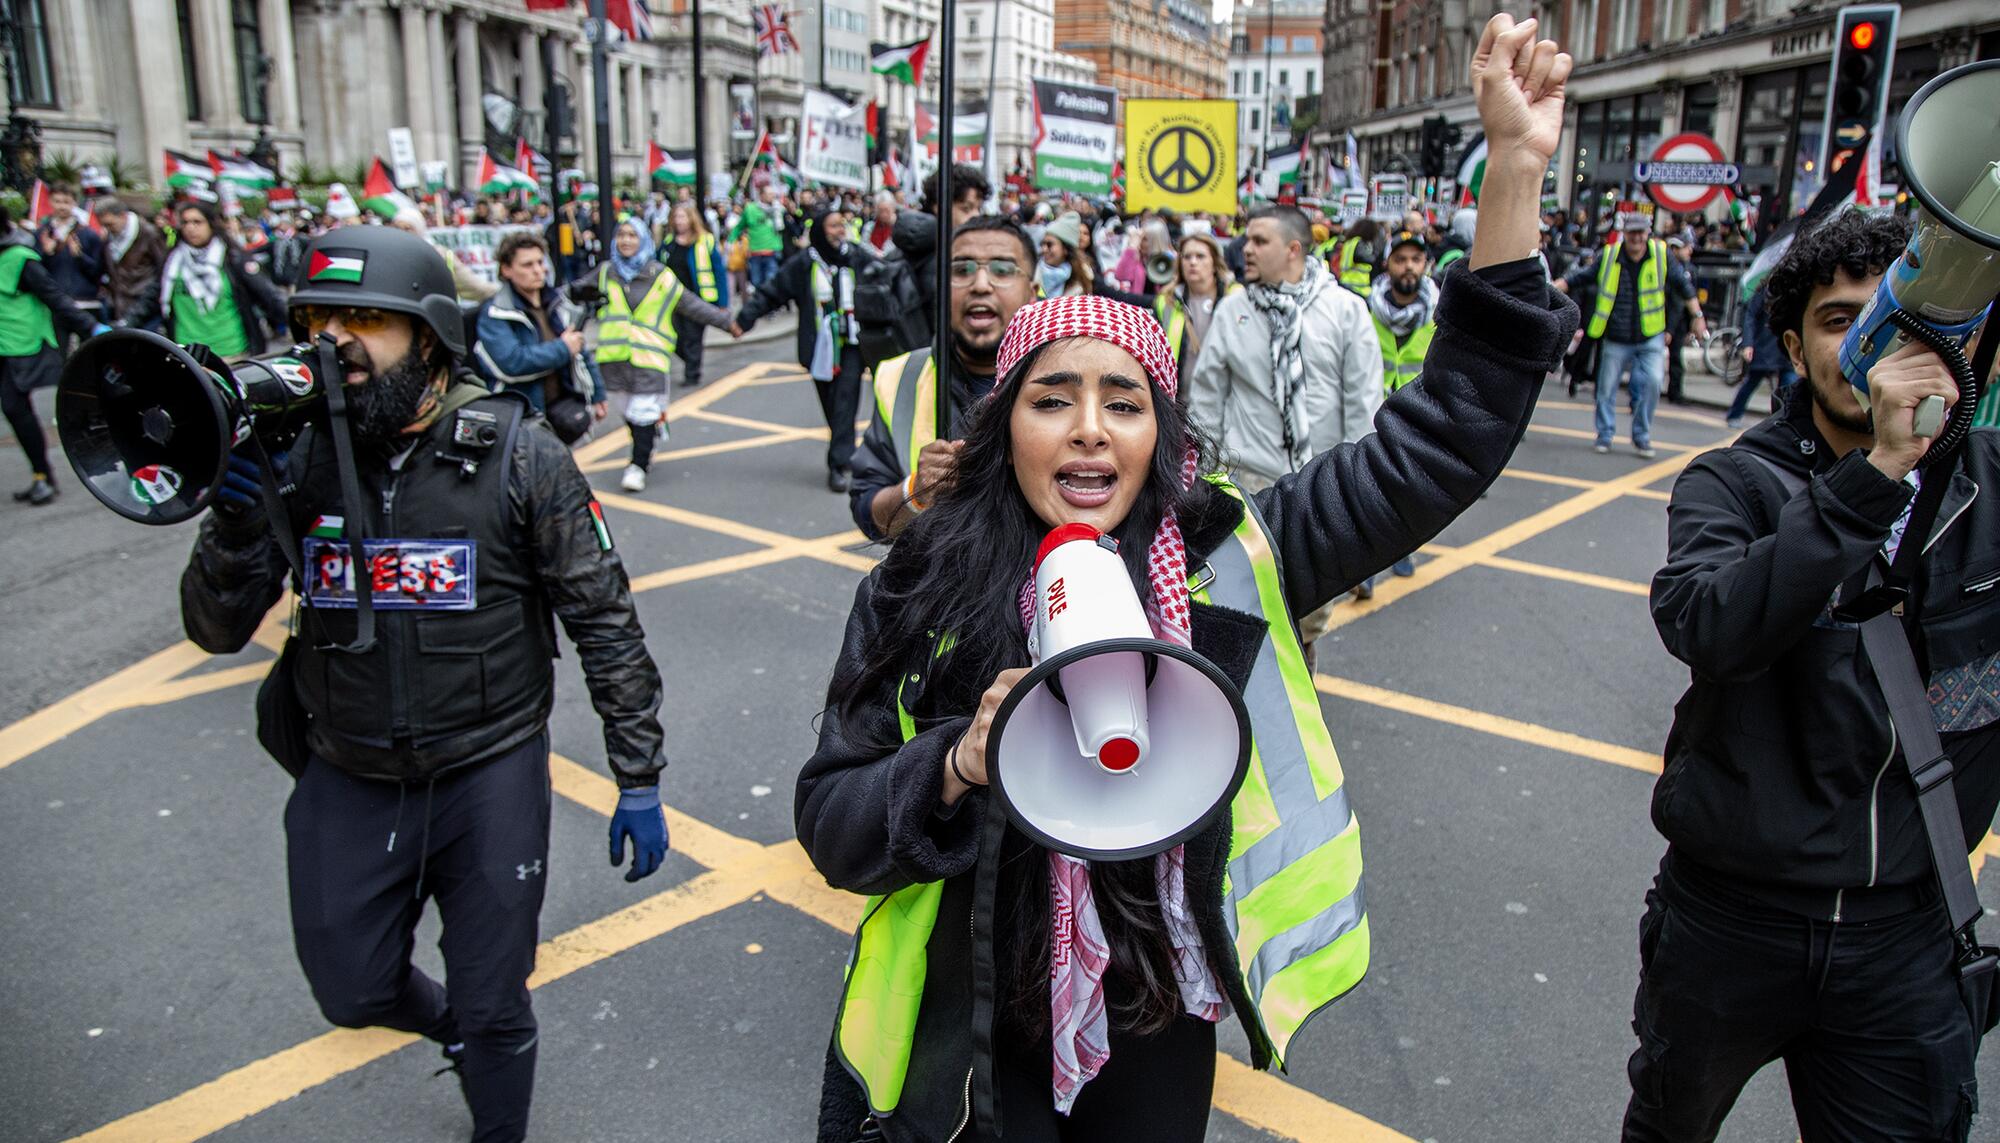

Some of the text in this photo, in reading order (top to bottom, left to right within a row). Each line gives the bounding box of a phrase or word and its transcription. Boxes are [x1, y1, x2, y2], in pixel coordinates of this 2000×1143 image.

[1050, 128, 1106, 152] Solidarity
[1042, 161, 1108, 187] Campaign
[1634, 162, 1739, 183] UNDERGROUND
[1047, 577, 1067, 621] PYLE
